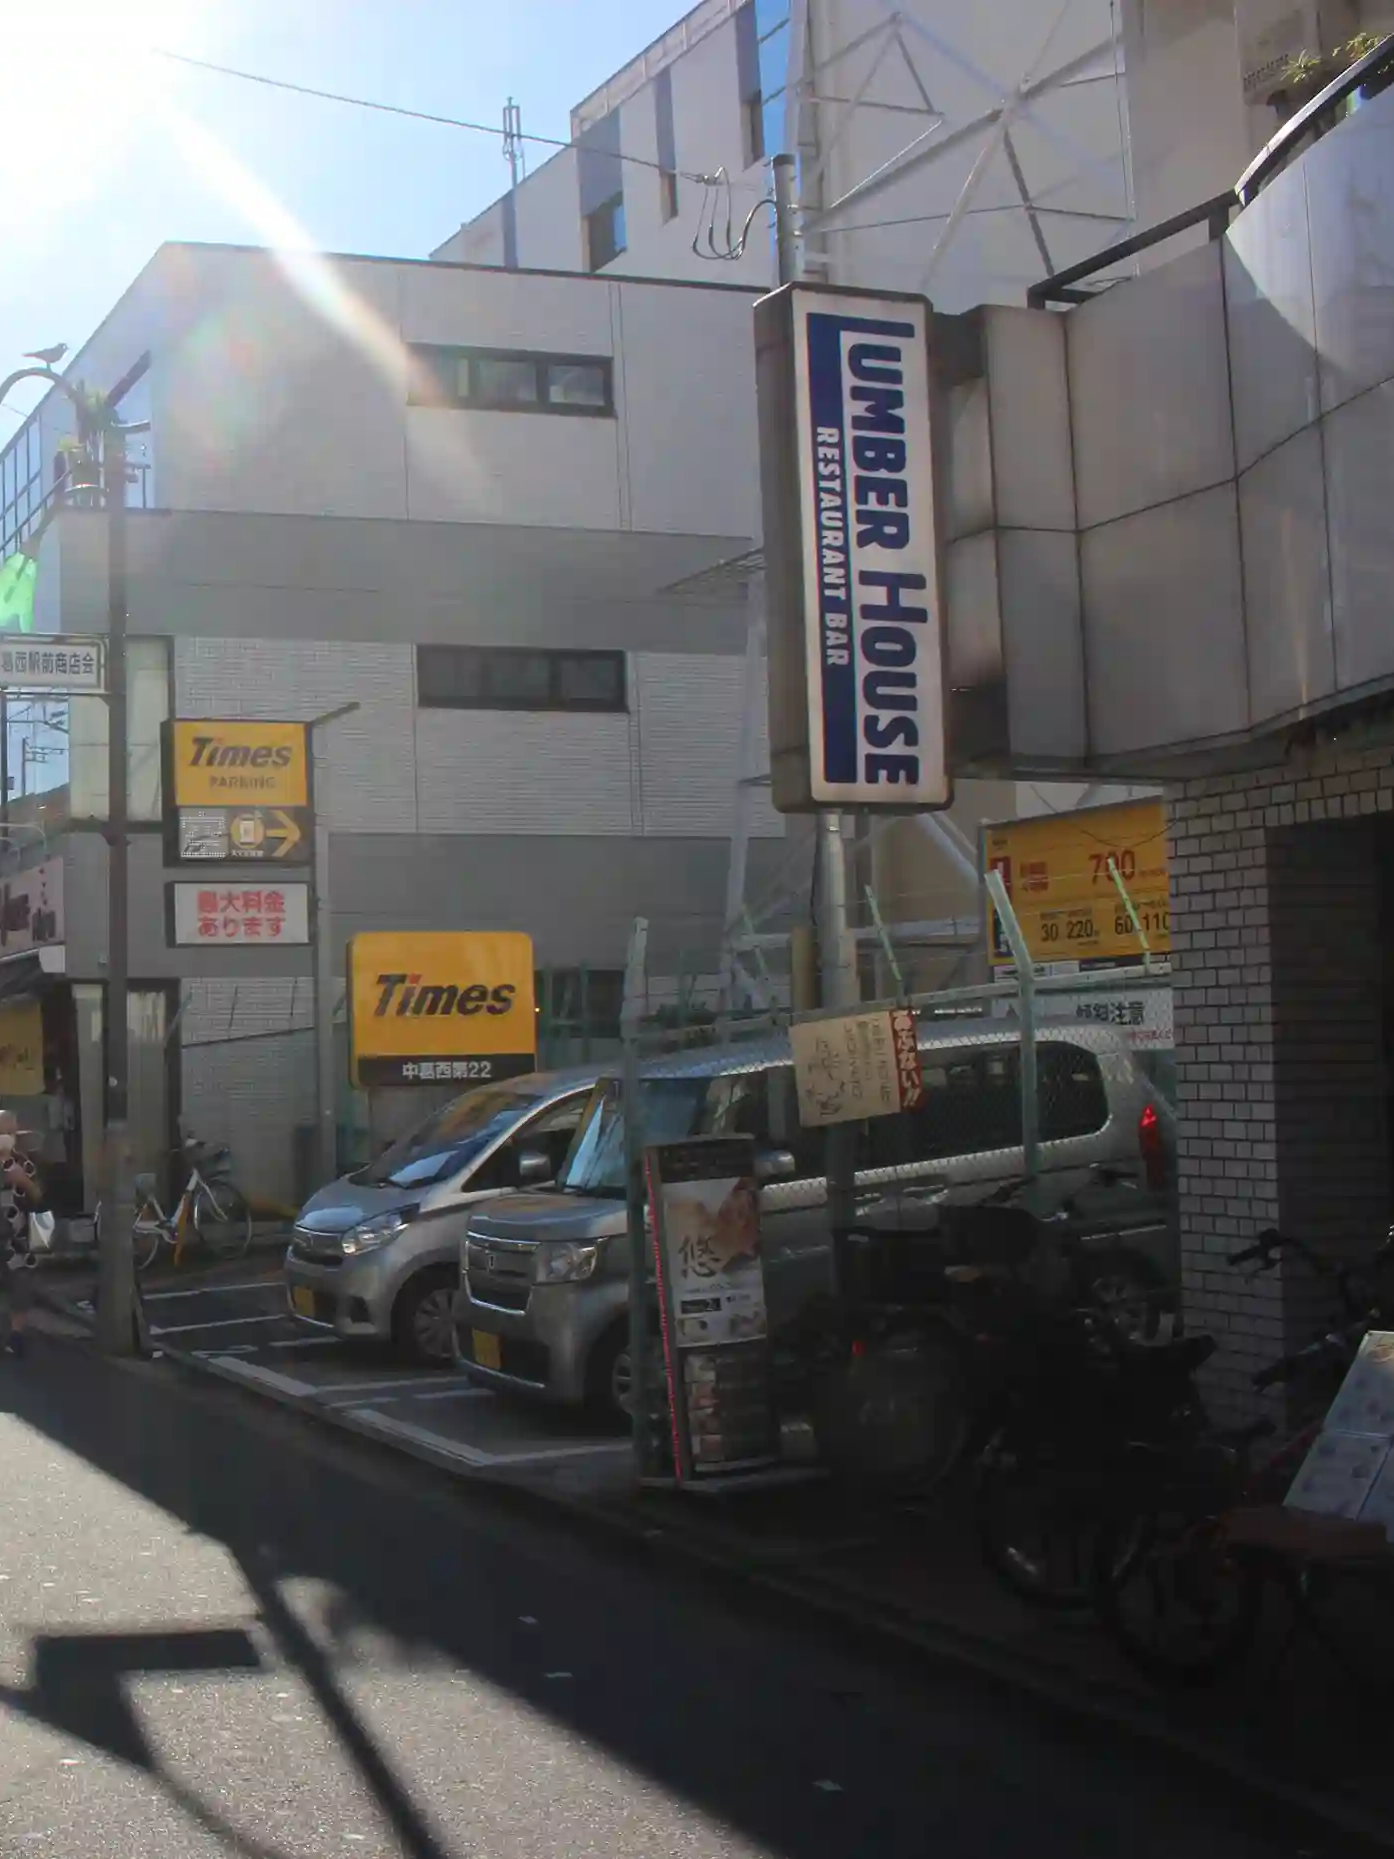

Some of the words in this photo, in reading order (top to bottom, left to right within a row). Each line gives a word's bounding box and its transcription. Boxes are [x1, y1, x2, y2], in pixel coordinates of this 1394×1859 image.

[839, 312, 916, 551] LUMBER
[817, 426, 848, 602] RESTAURANT
[824, 612, 849, 667] BAR
[858, 570, 928, 788] HOUSE
[187, 736, 293, 770] Times
[208, 775, 277, 790] PARKING
[197, 915, 287, 938] あります
[372, 973, 516, 1018] Times
